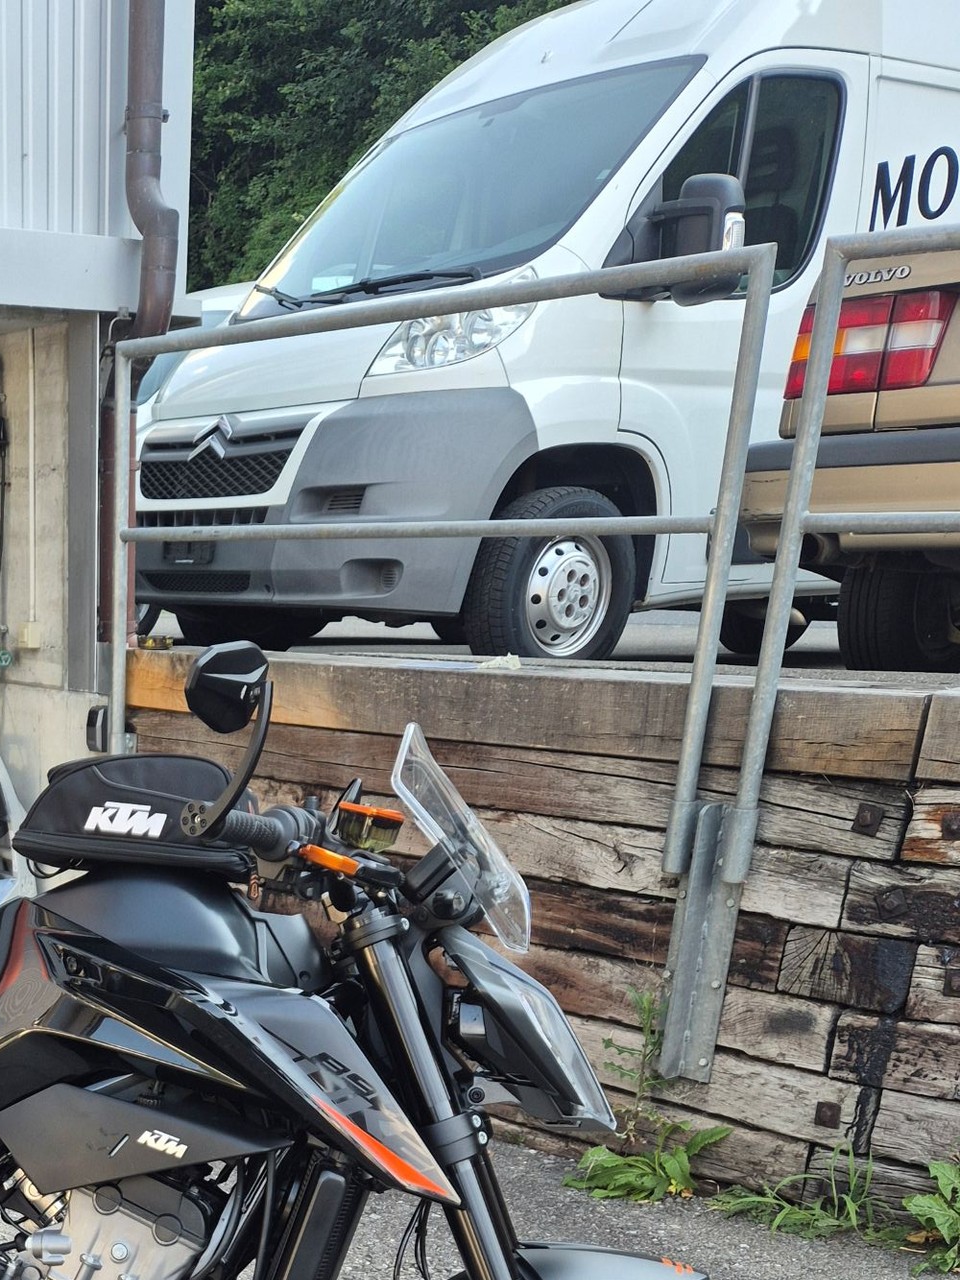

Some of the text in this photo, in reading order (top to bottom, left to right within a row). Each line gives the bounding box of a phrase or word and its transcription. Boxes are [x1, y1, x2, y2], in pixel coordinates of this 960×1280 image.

[869, 146, 959, 232] MO
[844, 265, 911, 287] VOLVO
[84, 801, 167, 838] KTM
[137, 1130, 188, 1158] KTM
